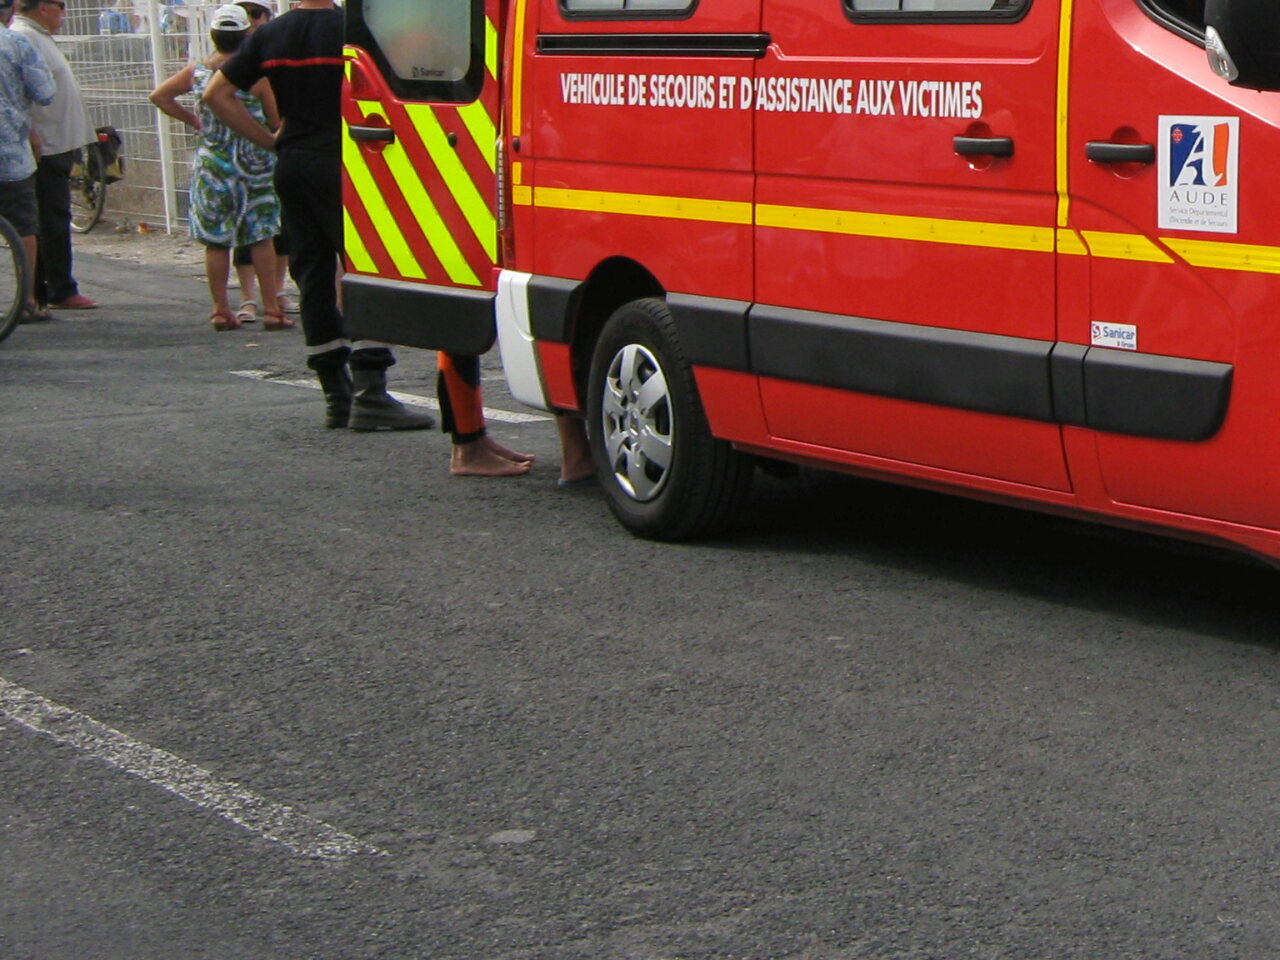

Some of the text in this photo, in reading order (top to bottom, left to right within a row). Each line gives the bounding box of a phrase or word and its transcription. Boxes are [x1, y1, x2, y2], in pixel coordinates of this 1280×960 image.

[560, 73, 982, 118] VEHICULE DE SECOURS ET D'ASSISTANCE AUX VICTIMES
[1103, 326, 1135, 340] Sanicar
